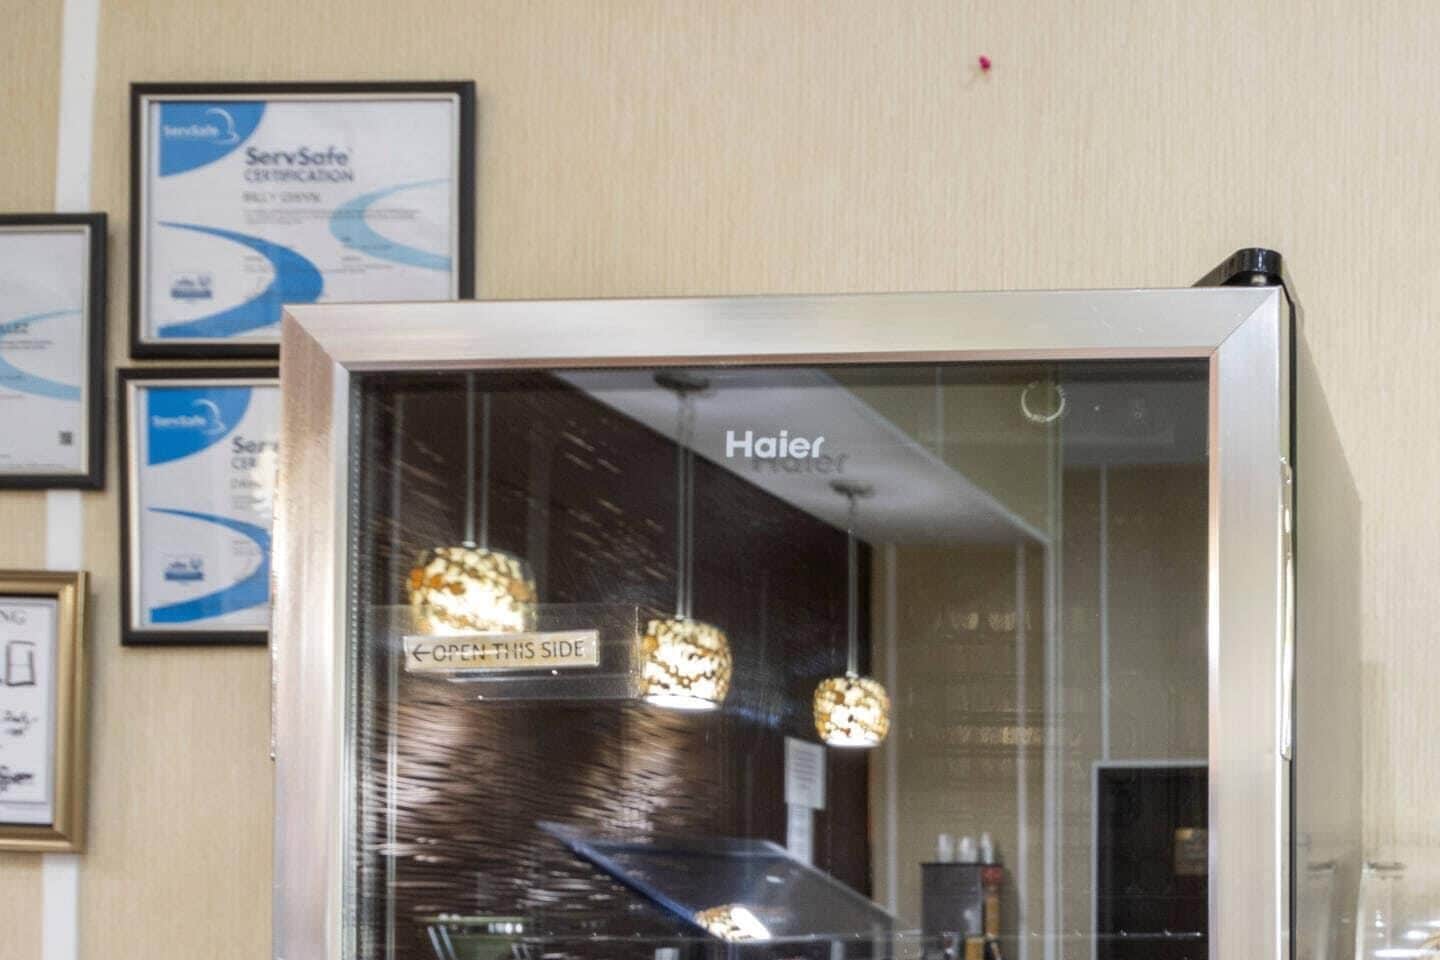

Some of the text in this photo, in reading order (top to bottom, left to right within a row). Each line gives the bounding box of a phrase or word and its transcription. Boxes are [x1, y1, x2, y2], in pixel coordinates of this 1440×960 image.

[245, 146, 350, 166] ServSafe
[244, 169, 355, 183] CERTIFICATION
[725, 430, 825, 459] Haier
[432, 640, 585, 663] OPEN THIS SIDE
